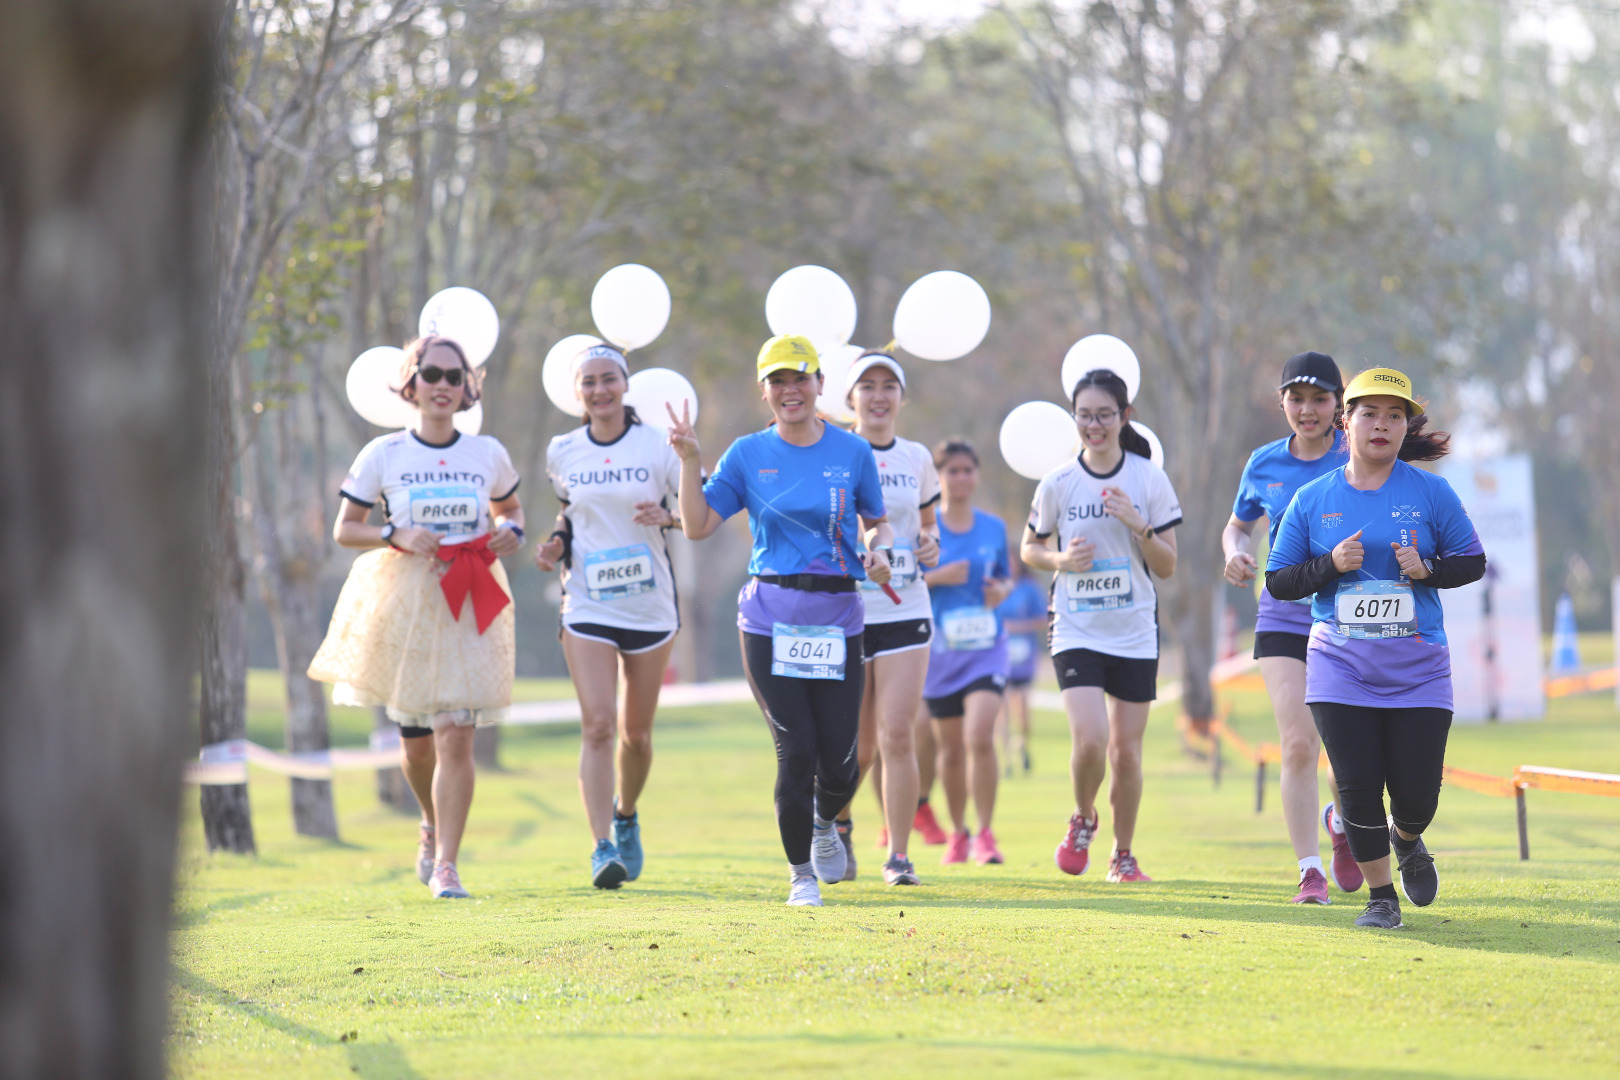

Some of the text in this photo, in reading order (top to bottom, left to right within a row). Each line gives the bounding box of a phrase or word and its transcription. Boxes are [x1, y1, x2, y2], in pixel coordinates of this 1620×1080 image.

[1373, 374, 1406, 388] SEIKO
[400, 471, 486, 487] SUUNTO
[569, 467, 650, 488] SUUNTO
[880, 474, 918, 489] UNTO
[829, 487, 837, 512] CROSS
[422, 504, 468, 518] PACER
[1400, 529, 1409, 549] CRO
[597, 563, 643, 583] PACER
[1076, 577, 1122, 593] PACER
[1354, 598, 1401, 618] 6071
[1398, 627, 1408, 636] 16
[788, 641, 833, 660] 6041
